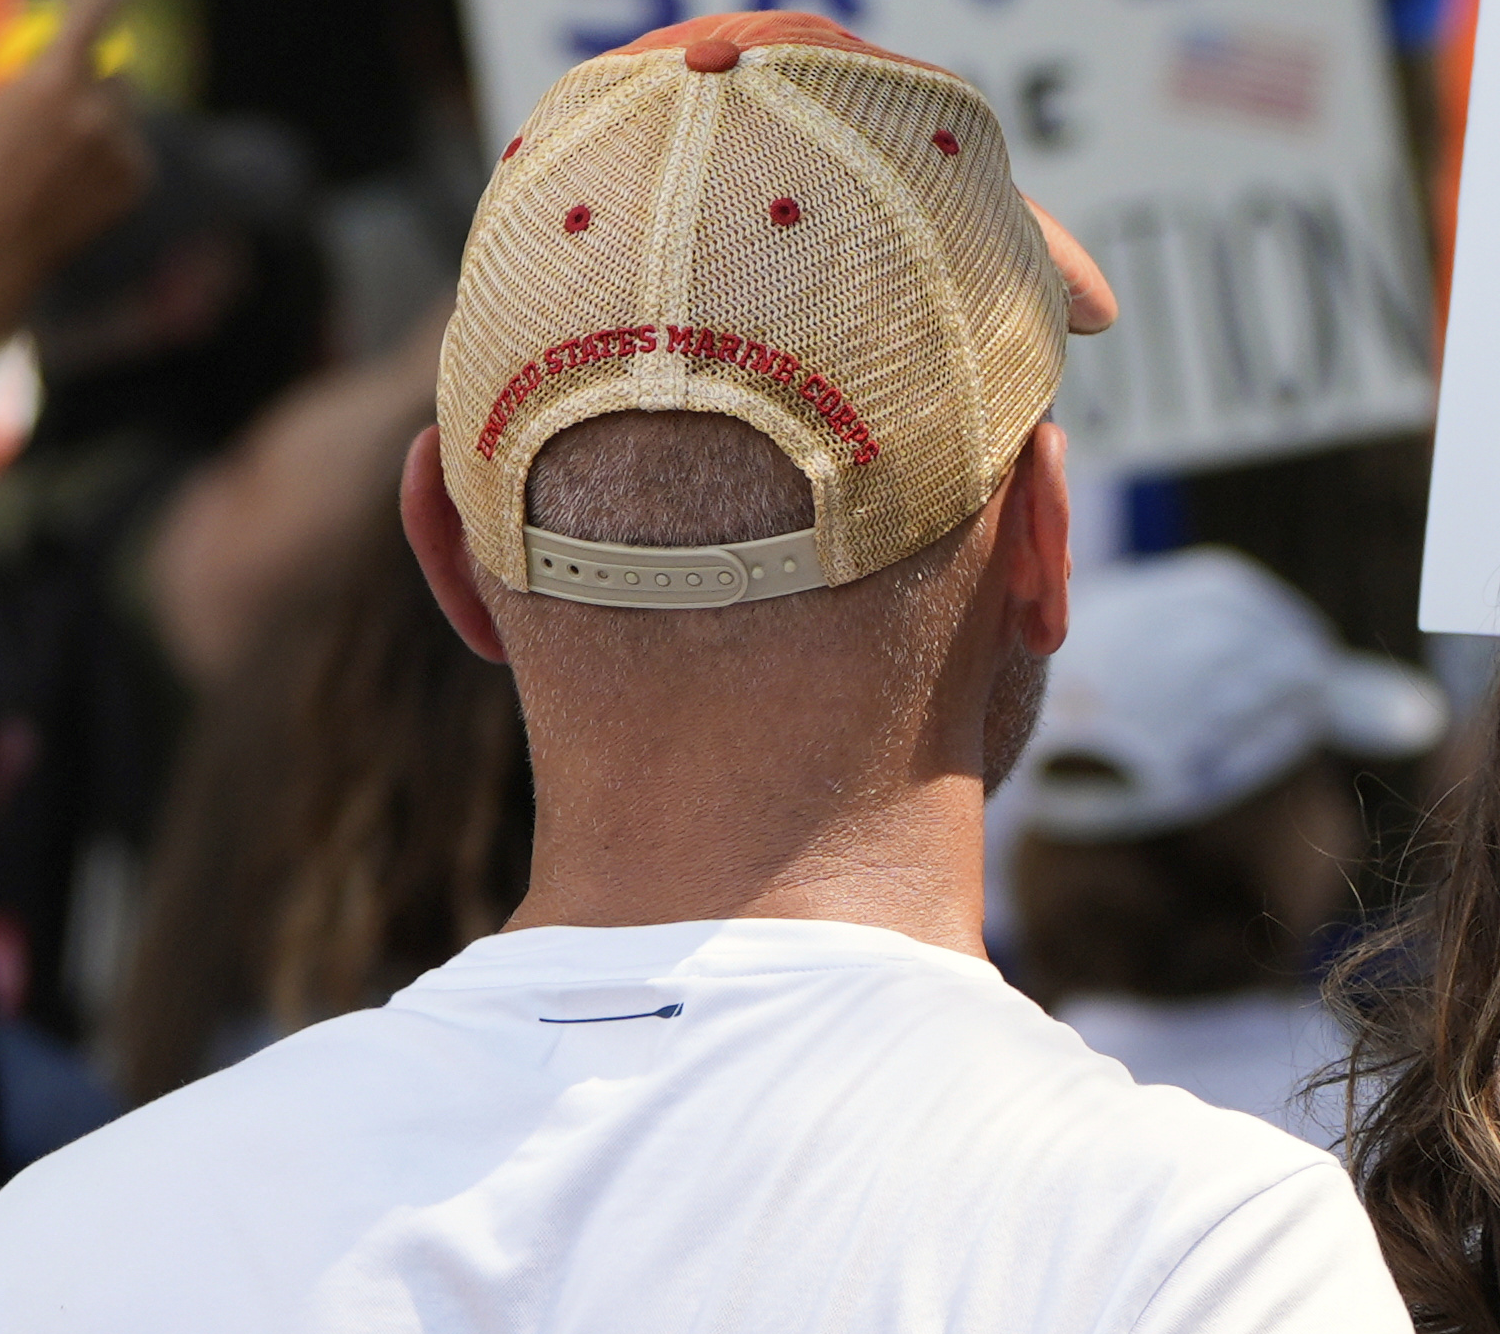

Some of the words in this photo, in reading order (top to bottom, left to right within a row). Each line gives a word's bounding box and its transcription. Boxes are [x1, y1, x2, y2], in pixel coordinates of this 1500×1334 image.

[544, 324, 657, 375] STATES
[666, 324, 801, 385] MARINE
[801, 373, 880, 466] CORPS
